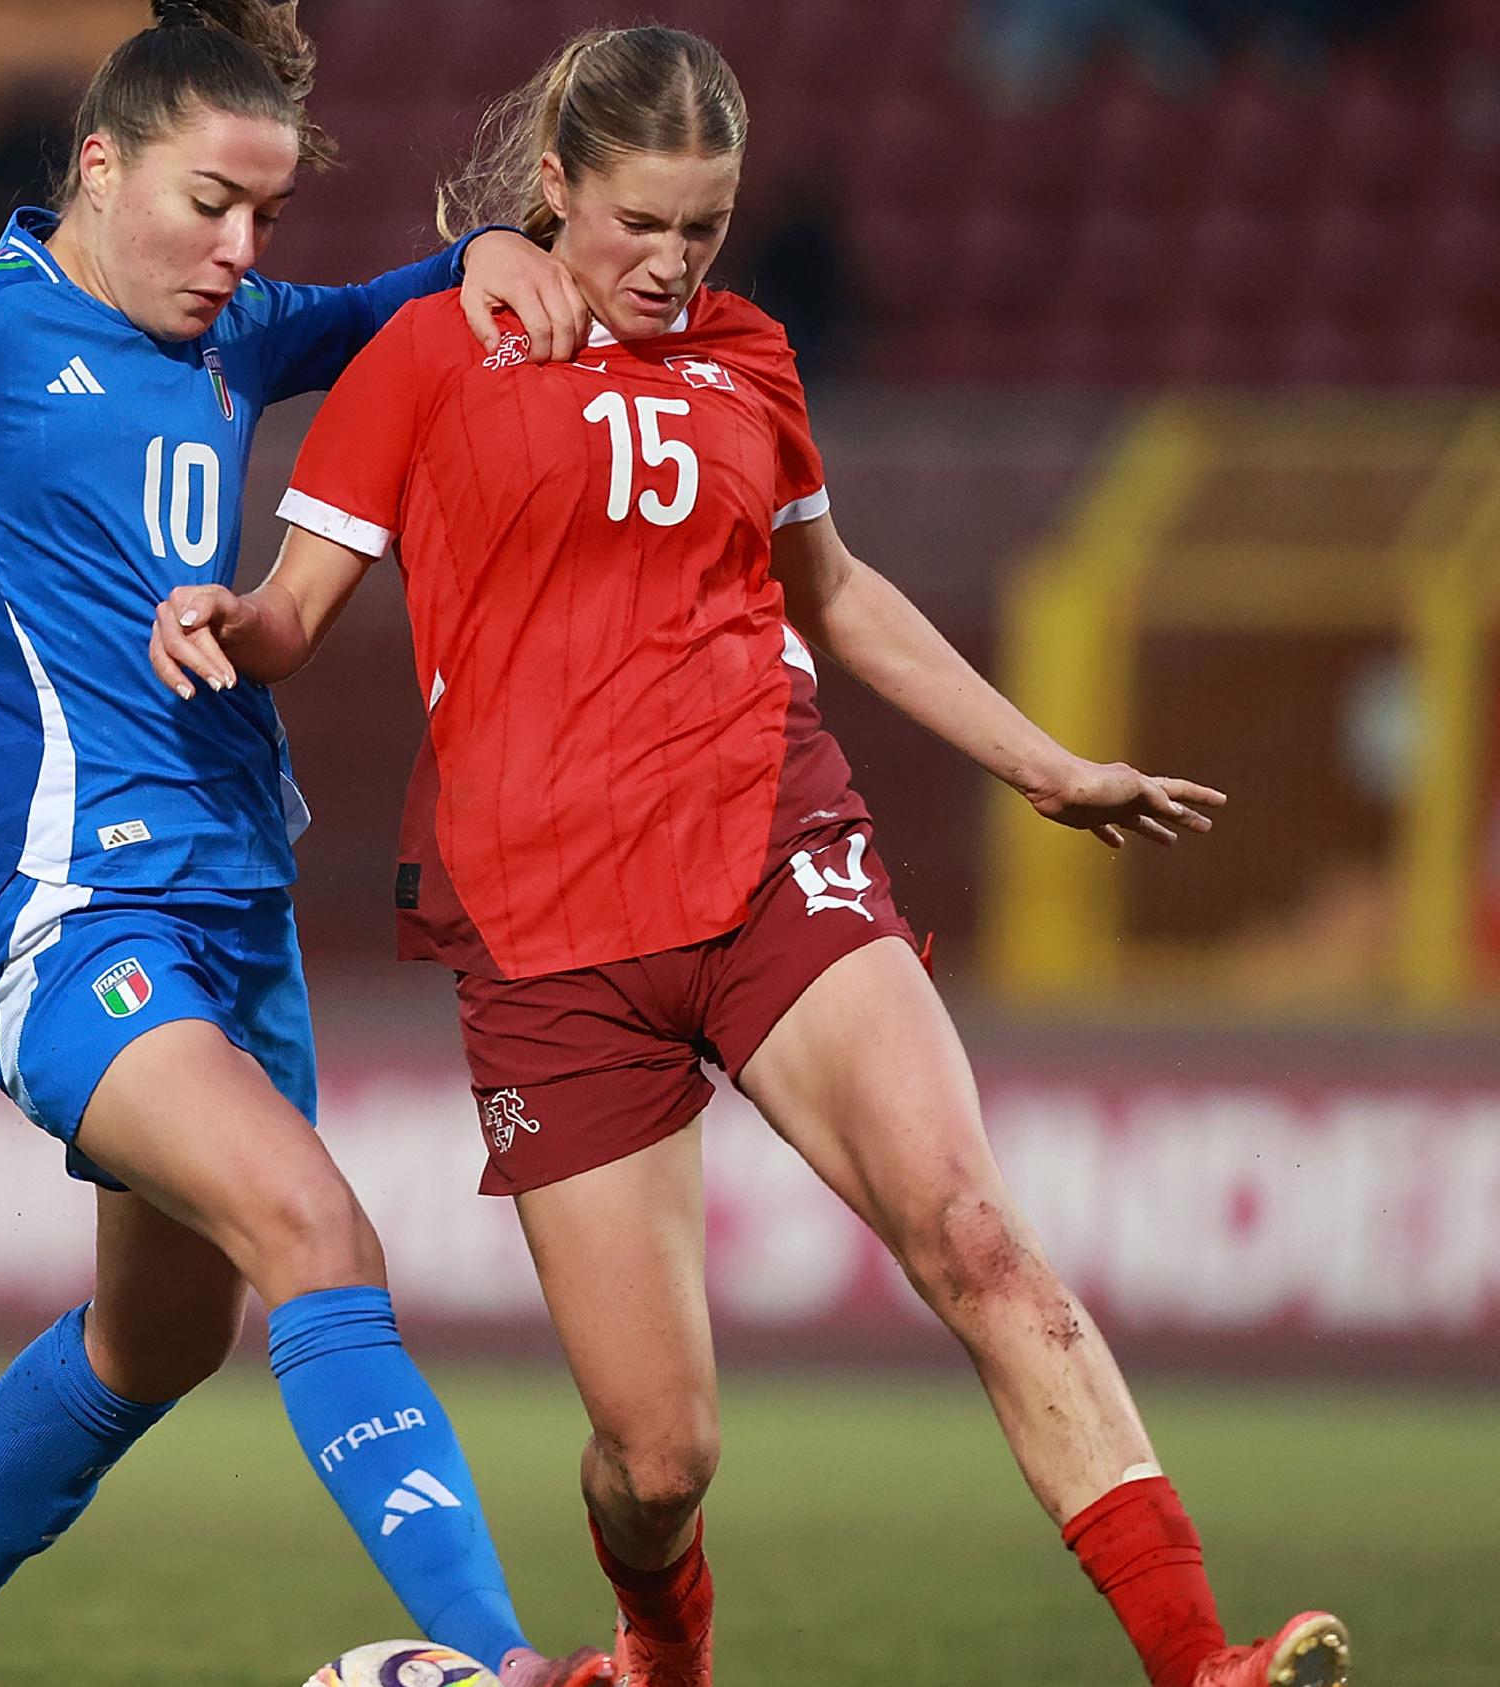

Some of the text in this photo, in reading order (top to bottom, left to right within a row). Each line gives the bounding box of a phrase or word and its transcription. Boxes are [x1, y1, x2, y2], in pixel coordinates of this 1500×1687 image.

[143, 435, 220, 567] 10
[583, 391, 699, 526] 15
[97, 961, 137, 994] ITALIA
[319, 1407, 427, 1473] ITALIA
